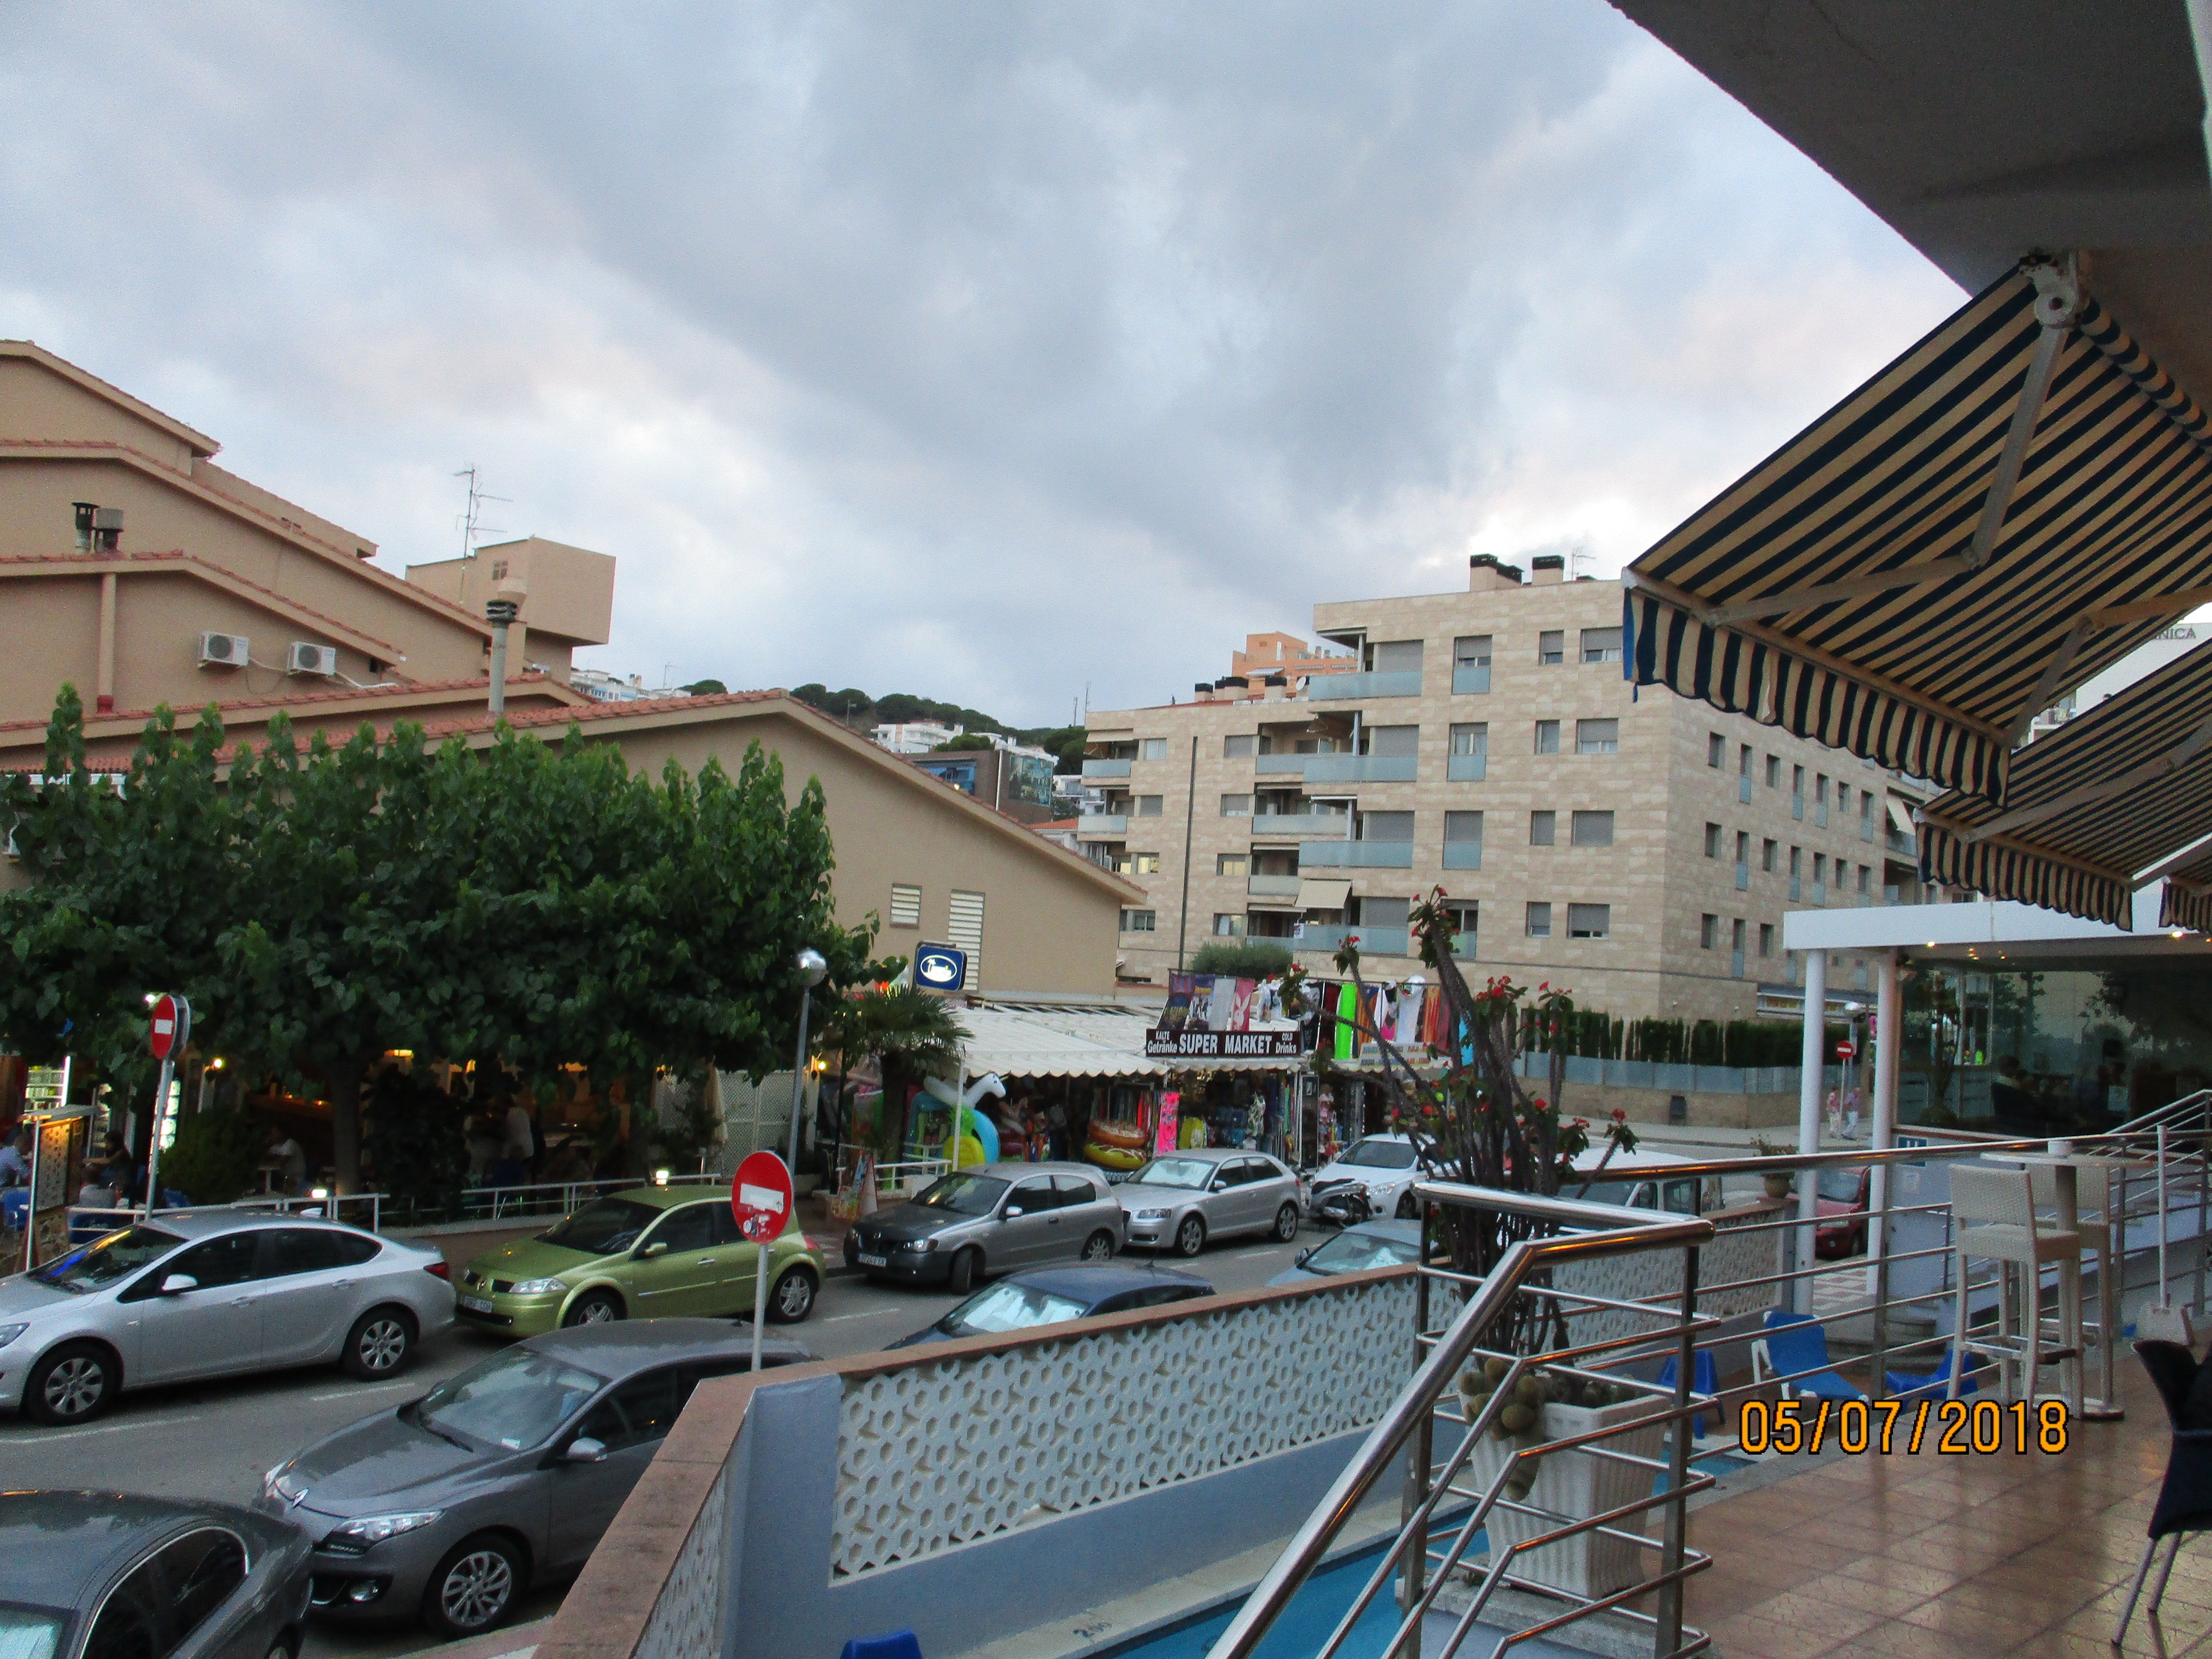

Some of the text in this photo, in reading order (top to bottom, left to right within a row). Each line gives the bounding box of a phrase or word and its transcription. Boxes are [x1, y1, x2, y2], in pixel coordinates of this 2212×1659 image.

[2154, 627, 2197, 639] NICA
[1156, 1031, 1170, 1040] KALTE
[1282, 1032, 1293, 1041] COLD
[1147, 1040, 1177, 1053] Getränke
[1179, 1033, 1272, 1054] SUPER MARKET
[1276, 1042, 1297, 1054] Drinks
